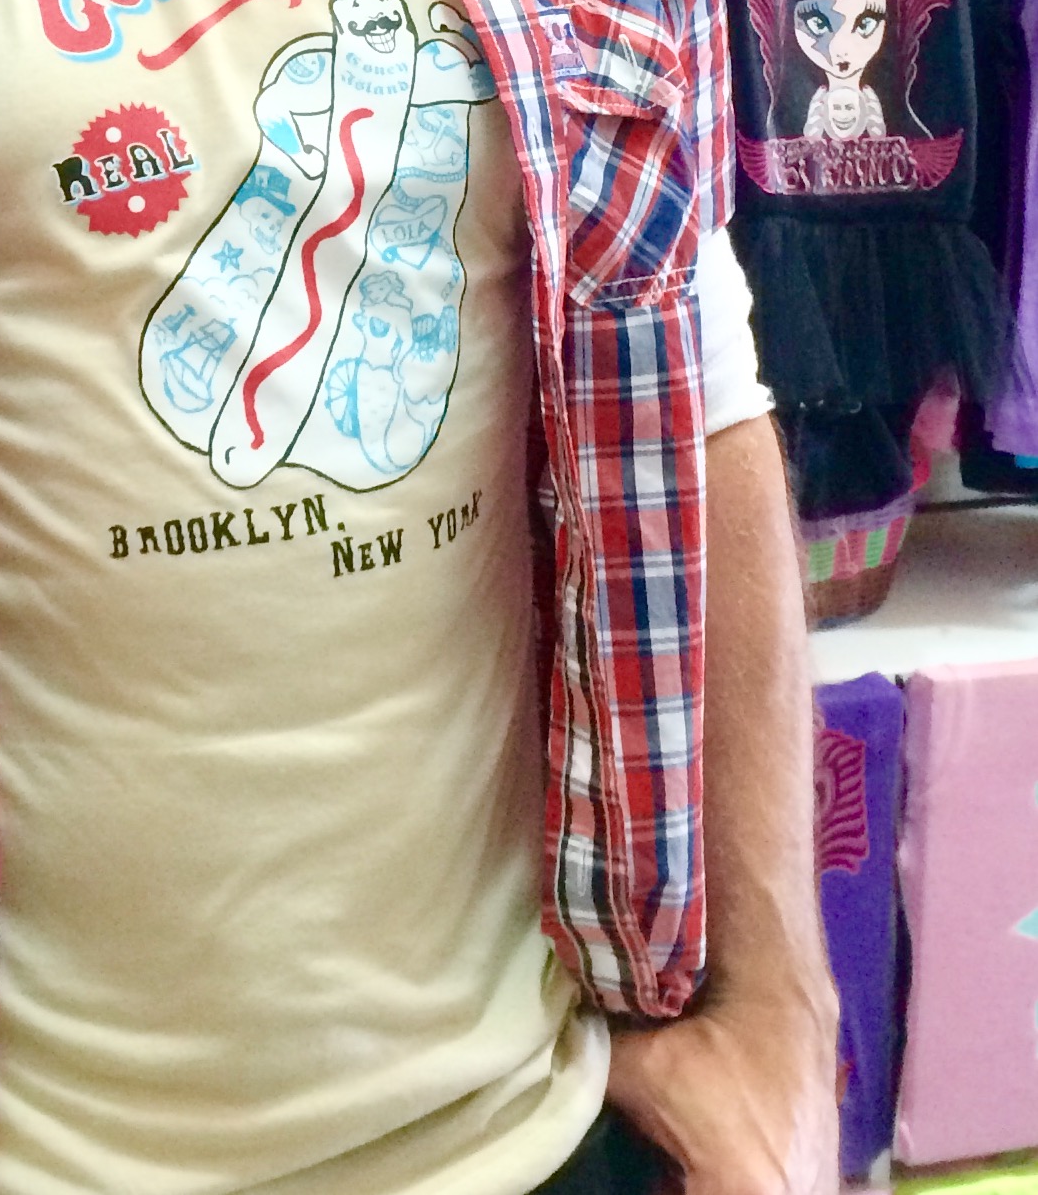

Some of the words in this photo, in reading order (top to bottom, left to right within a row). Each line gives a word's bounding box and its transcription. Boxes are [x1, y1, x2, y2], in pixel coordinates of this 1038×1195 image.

[51, 129, 198, 205] REAL
[381, 220, 433, 244] LOLA
[330, 528, 405, 578] NEW
[428, 489, 483, 549] YORK
